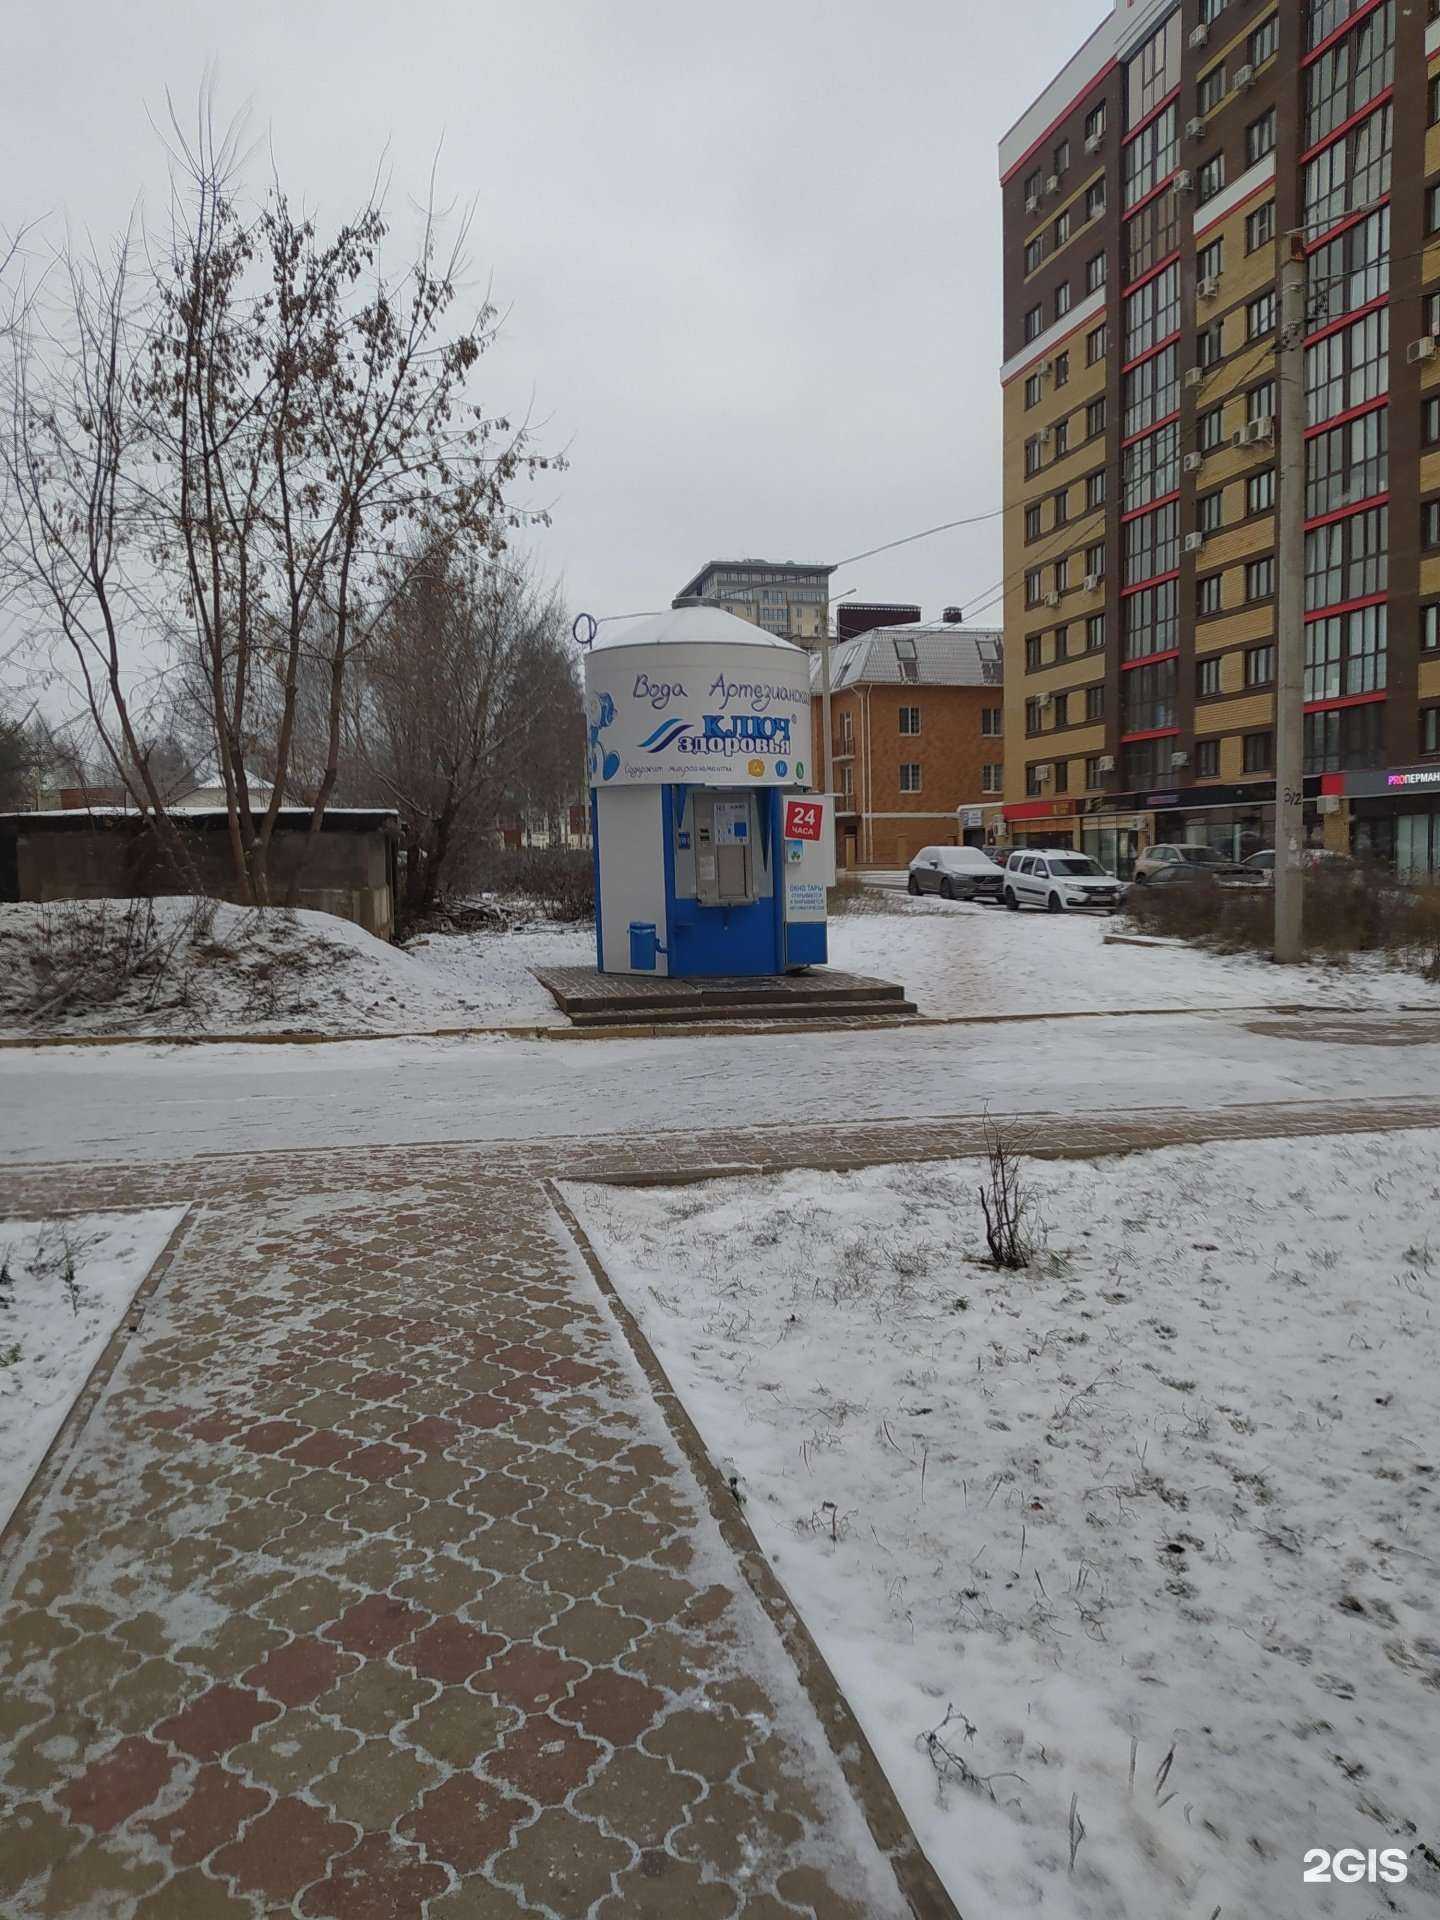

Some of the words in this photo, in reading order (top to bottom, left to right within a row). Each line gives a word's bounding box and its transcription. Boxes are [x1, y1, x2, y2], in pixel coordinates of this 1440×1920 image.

[632, 672, 689, 710] Вода
[793, 806, 816, 826] 24
[791, 826, 814, 835] ЧАСА
